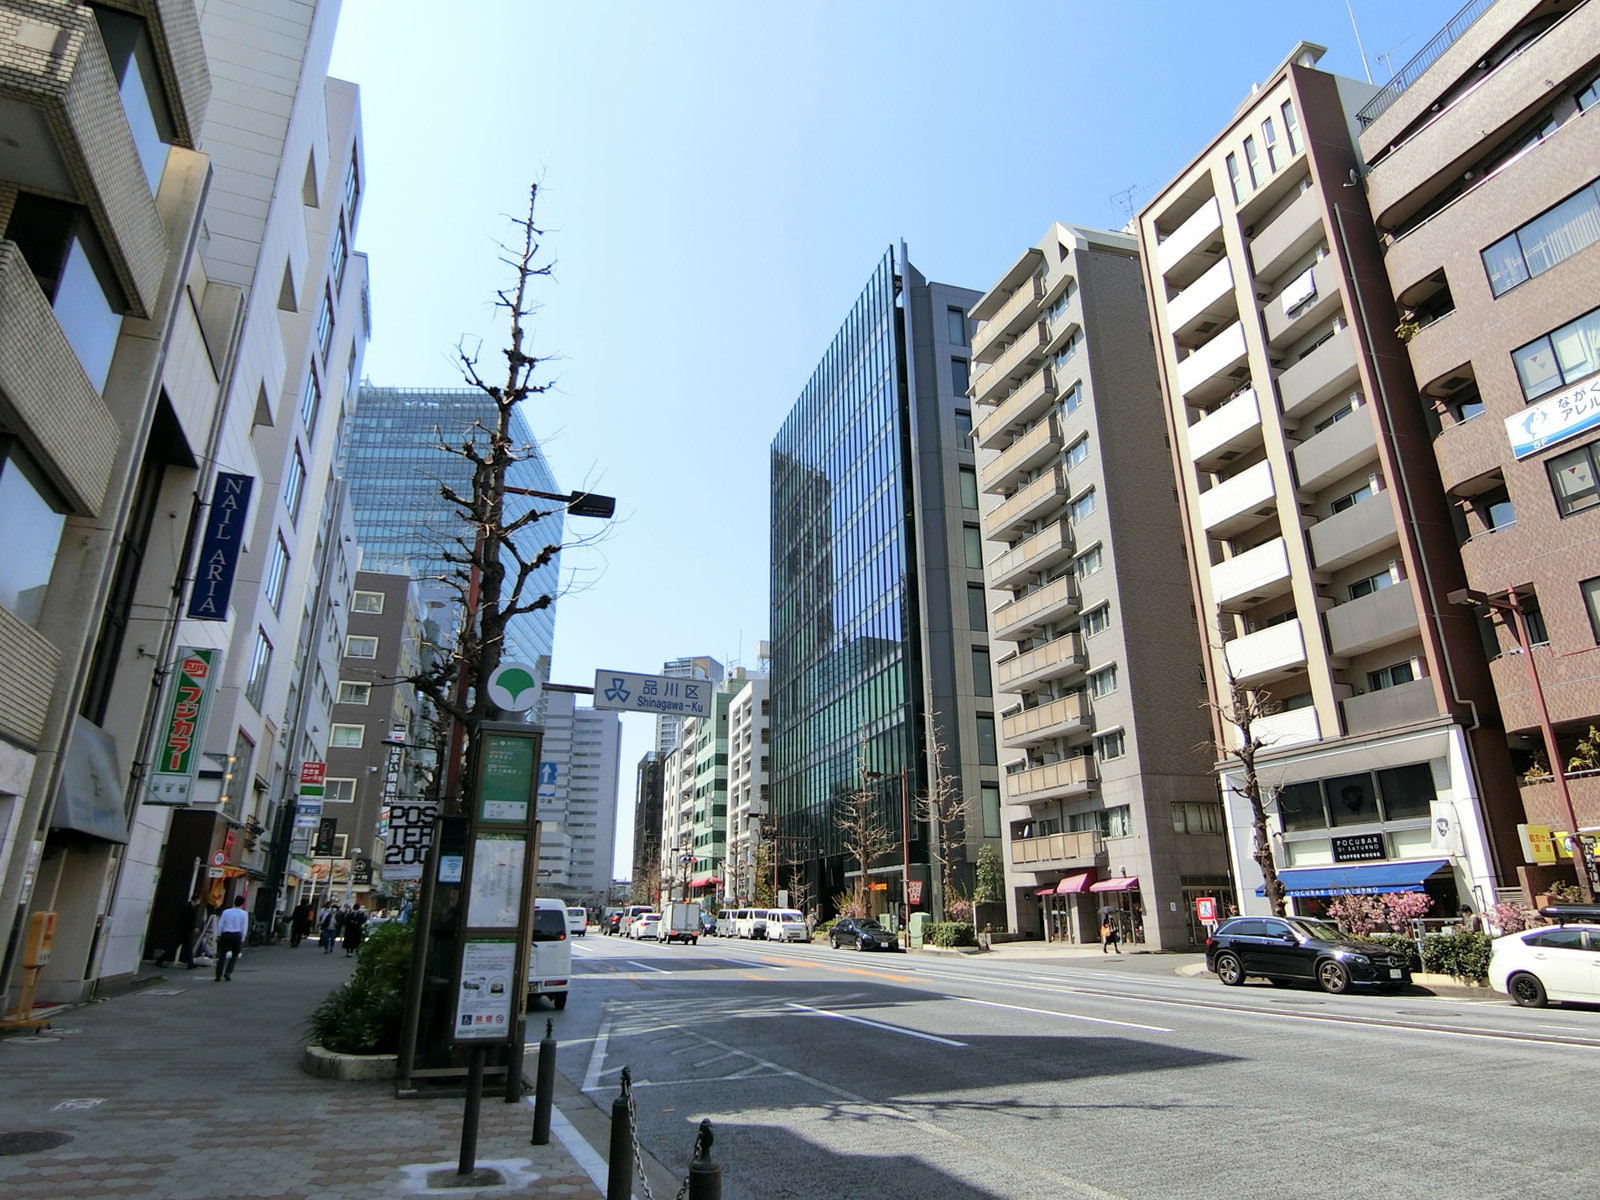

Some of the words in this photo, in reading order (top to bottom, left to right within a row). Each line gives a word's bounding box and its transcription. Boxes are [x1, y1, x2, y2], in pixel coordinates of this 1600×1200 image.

[216, 478, 245, 540] NAIL
[199, 549, 227, 613] ARIA
[643, 680, 699, 699] 品川区
[169, 687, 202, 770] フジカラー
[389, 805, 438, 825] POS
[1336, 837, 1378, 846] POCUBAR
[1347, 844, 1379, 852] SATURNO
